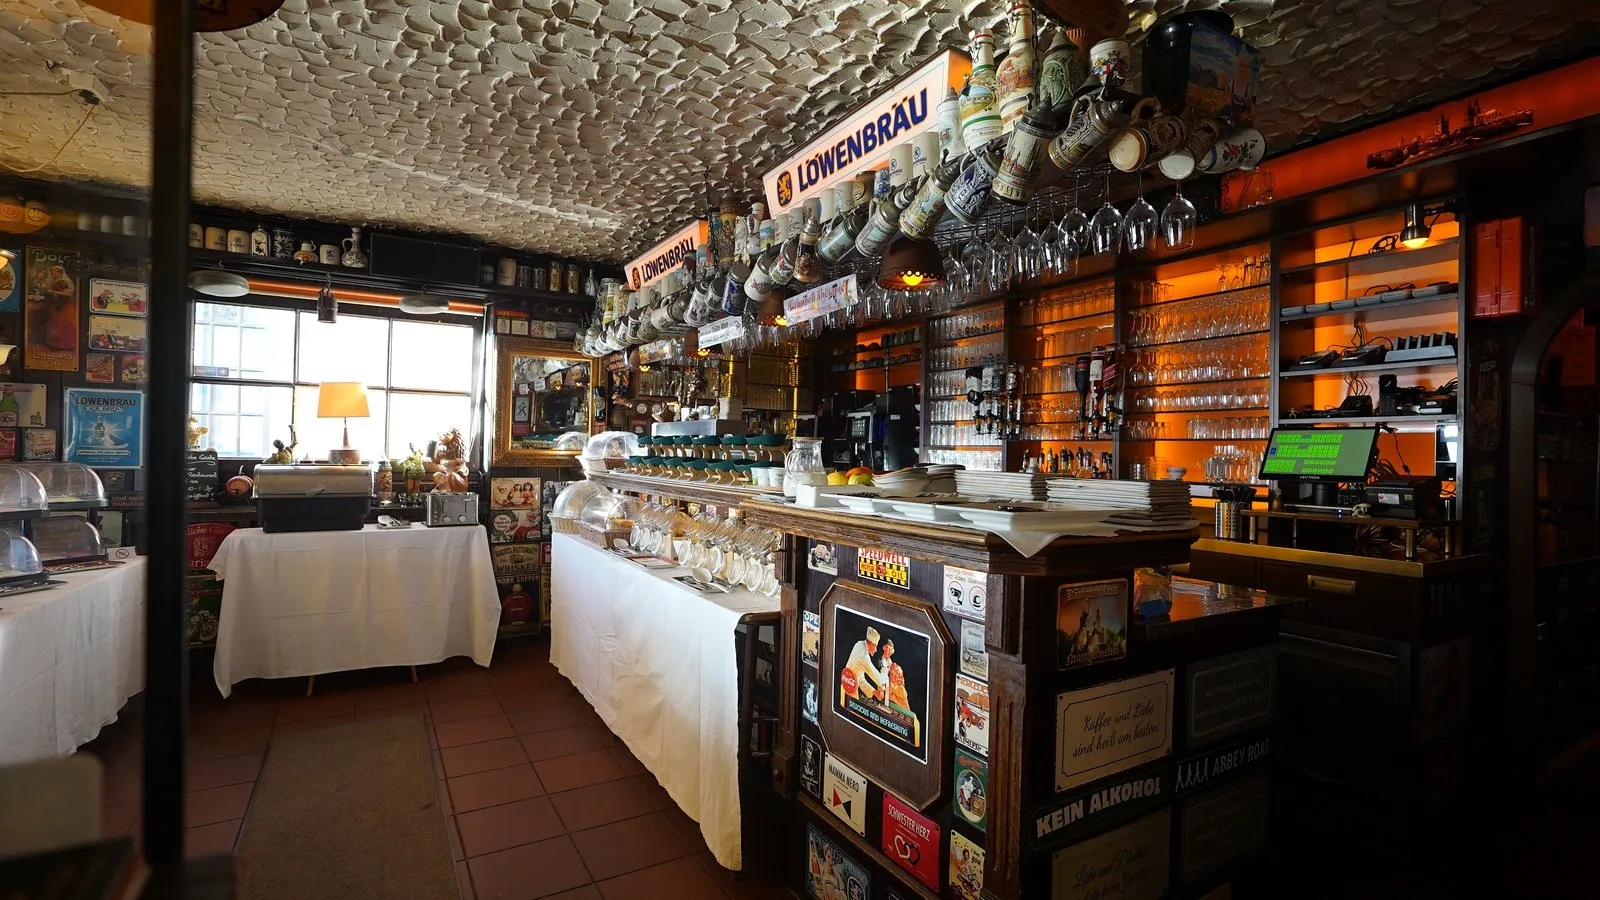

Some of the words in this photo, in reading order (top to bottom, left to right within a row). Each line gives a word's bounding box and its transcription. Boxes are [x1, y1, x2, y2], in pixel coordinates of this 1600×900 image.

[797, 87, 927, 193] LÖWENBRÄU
[641, 236, 694, 282] LÖWENBRÄU
[860, 547, 907, 566] SPEEDWELL
[891, 570, 903, 579] OIL
[804, 612, 819, 628] OPE
[880, 716, 908, 737] REFRESHING
[1083, 712, 1112, 733] Kaffee
[1114, 710, 1131, 723] und
[1132, 704, 1154, 721] Liebe
[1072, 740, 1094, 758] sind
[1095, 733, 1116, 753] heiß
[1117, 735, 1131, 747] am
[1212, 745, 1246, 777] ABBEY
[1036, 801, 1084, 839] KEIN
[1089, 776, 1161, 814] ALKOHOL
